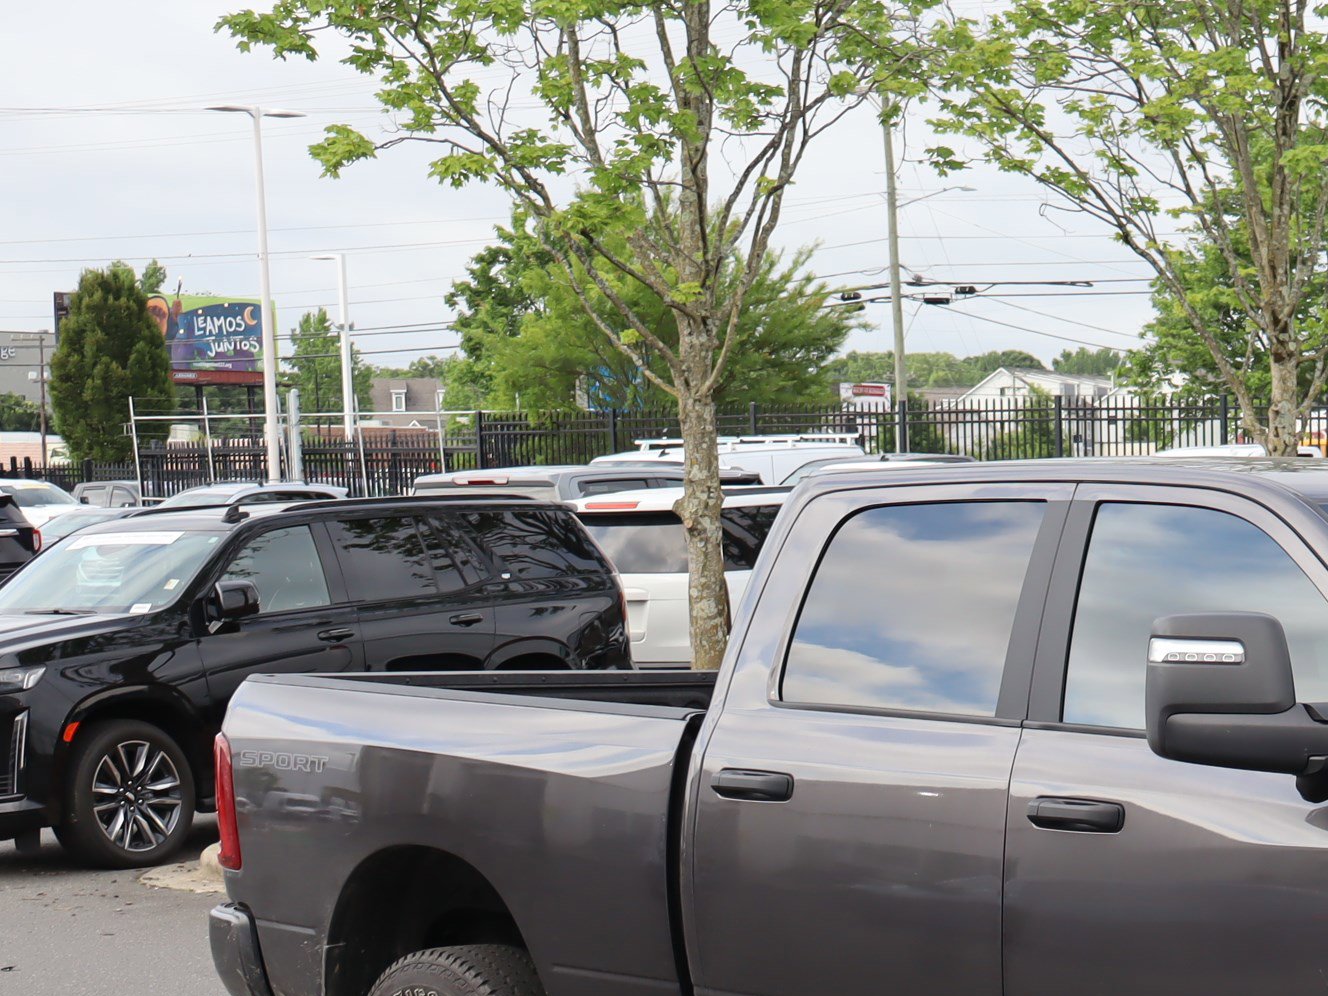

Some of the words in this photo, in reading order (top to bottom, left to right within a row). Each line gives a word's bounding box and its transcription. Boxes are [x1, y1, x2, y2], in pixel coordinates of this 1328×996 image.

[193, 315, 245, 336] LEAMOS
[207, 336, 260, 357] JUNTOS
[240, 749, 329, 773] SPORT
